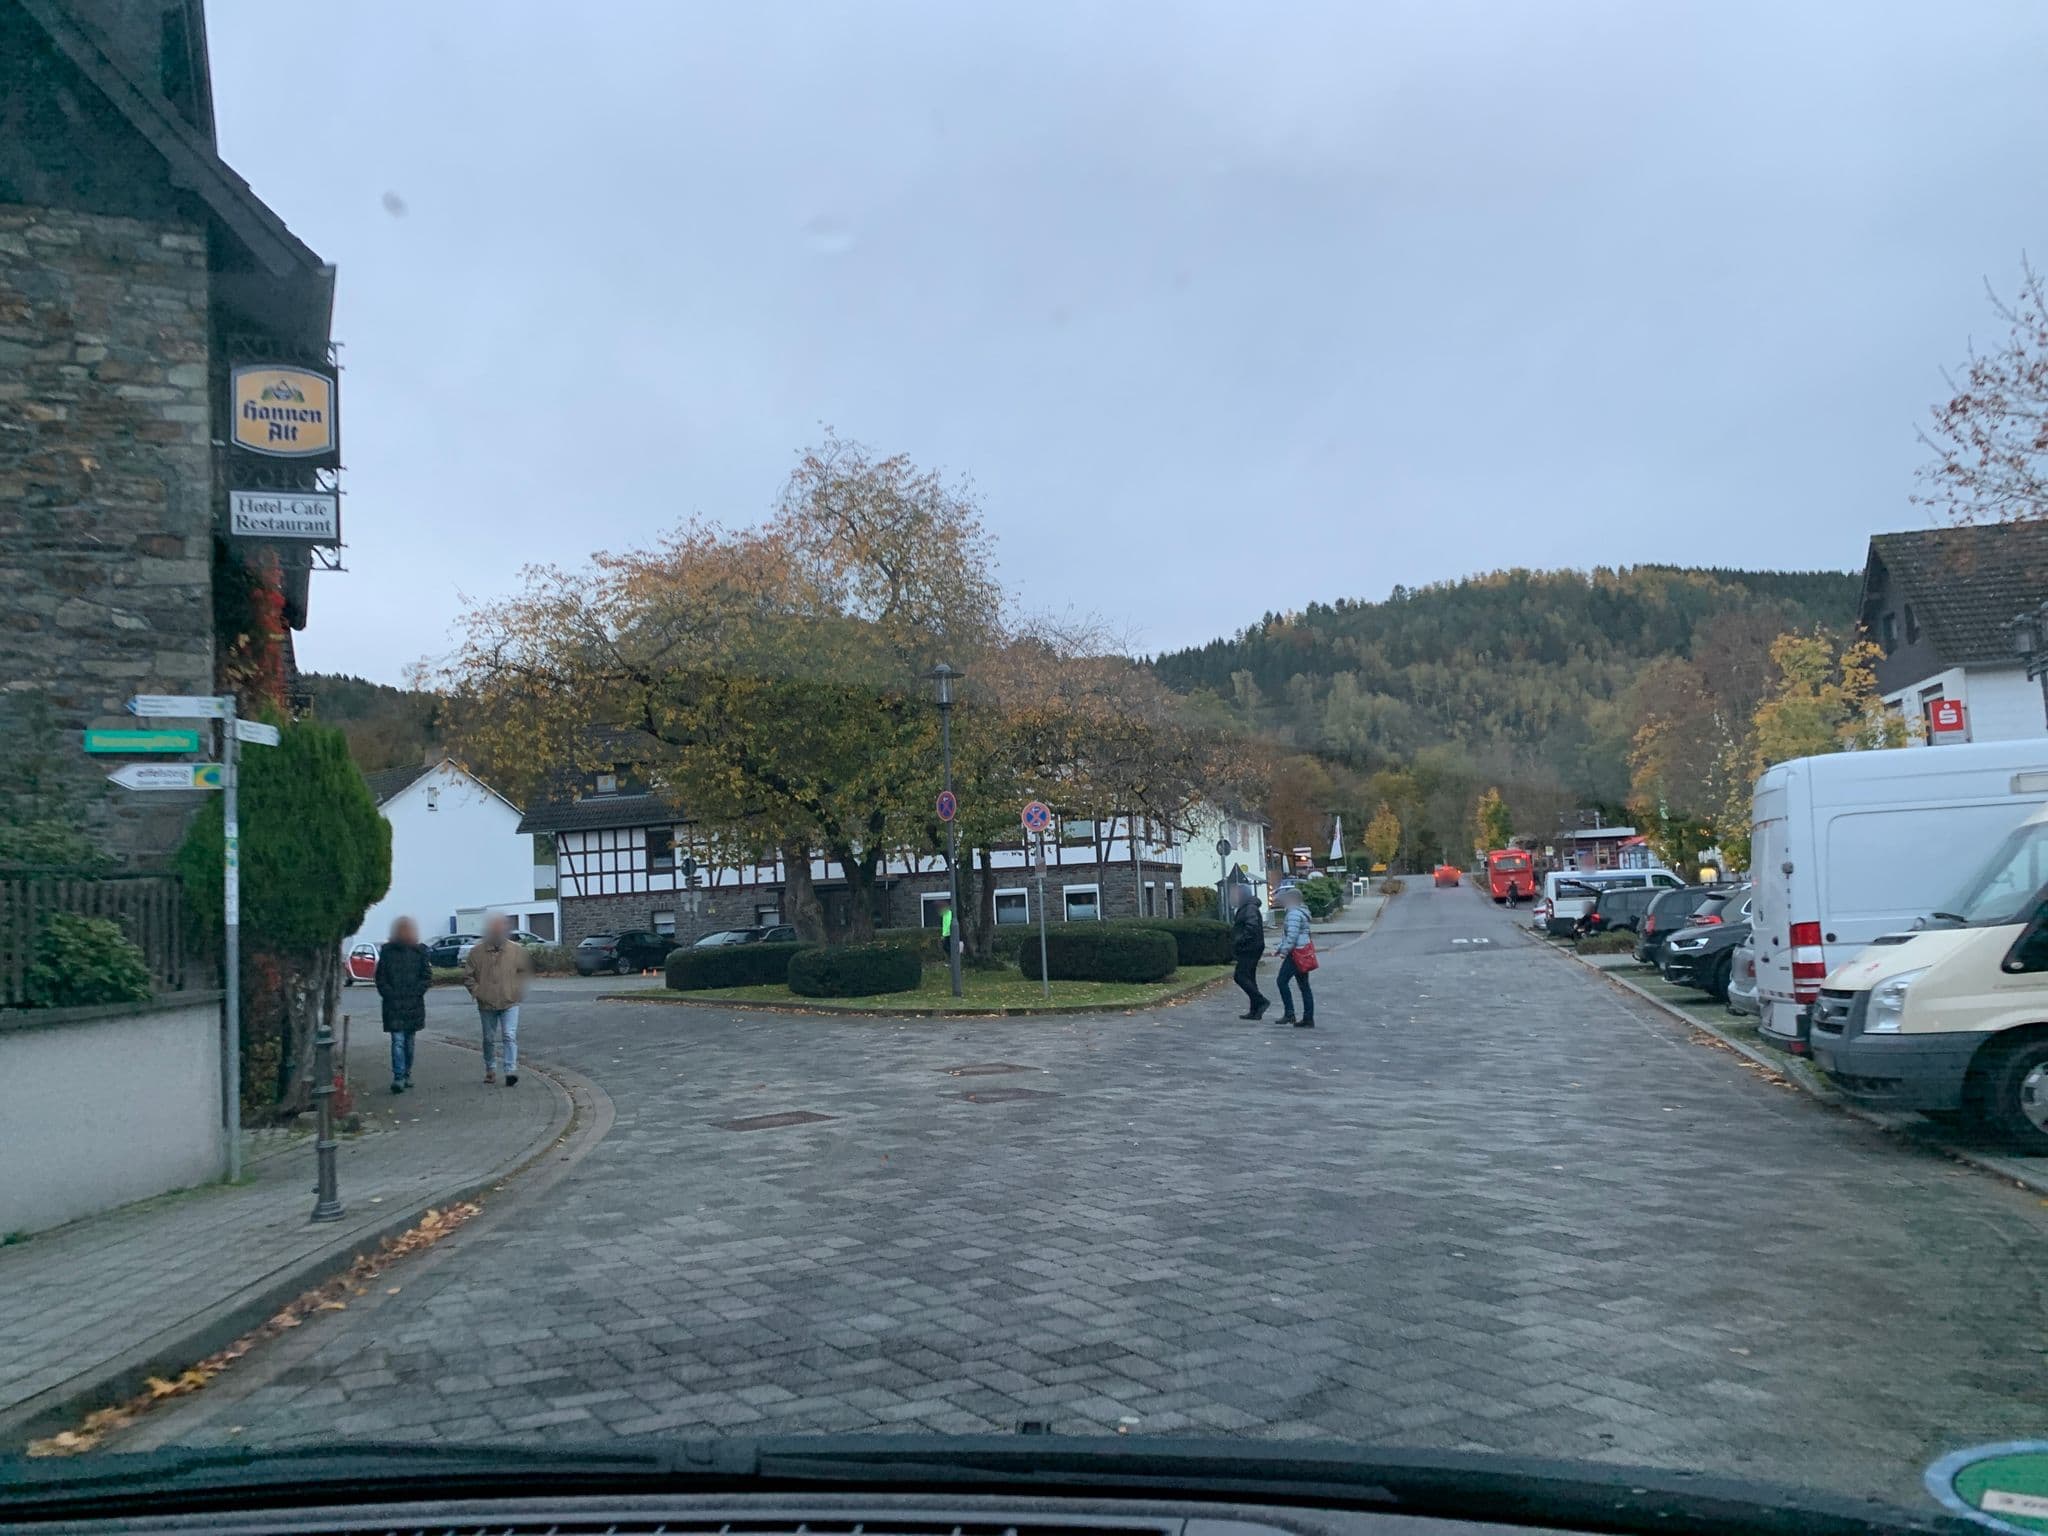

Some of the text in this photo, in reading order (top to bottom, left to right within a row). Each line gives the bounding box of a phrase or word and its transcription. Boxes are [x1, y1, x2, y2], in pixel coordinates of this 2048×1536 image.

[243, 400, 323, 424] Hannen
[268, 422, 299, 442] Alt
[239, 498, 328, 516] Hotel-Cafe
[236, 515, 332, 533] Restaurant
